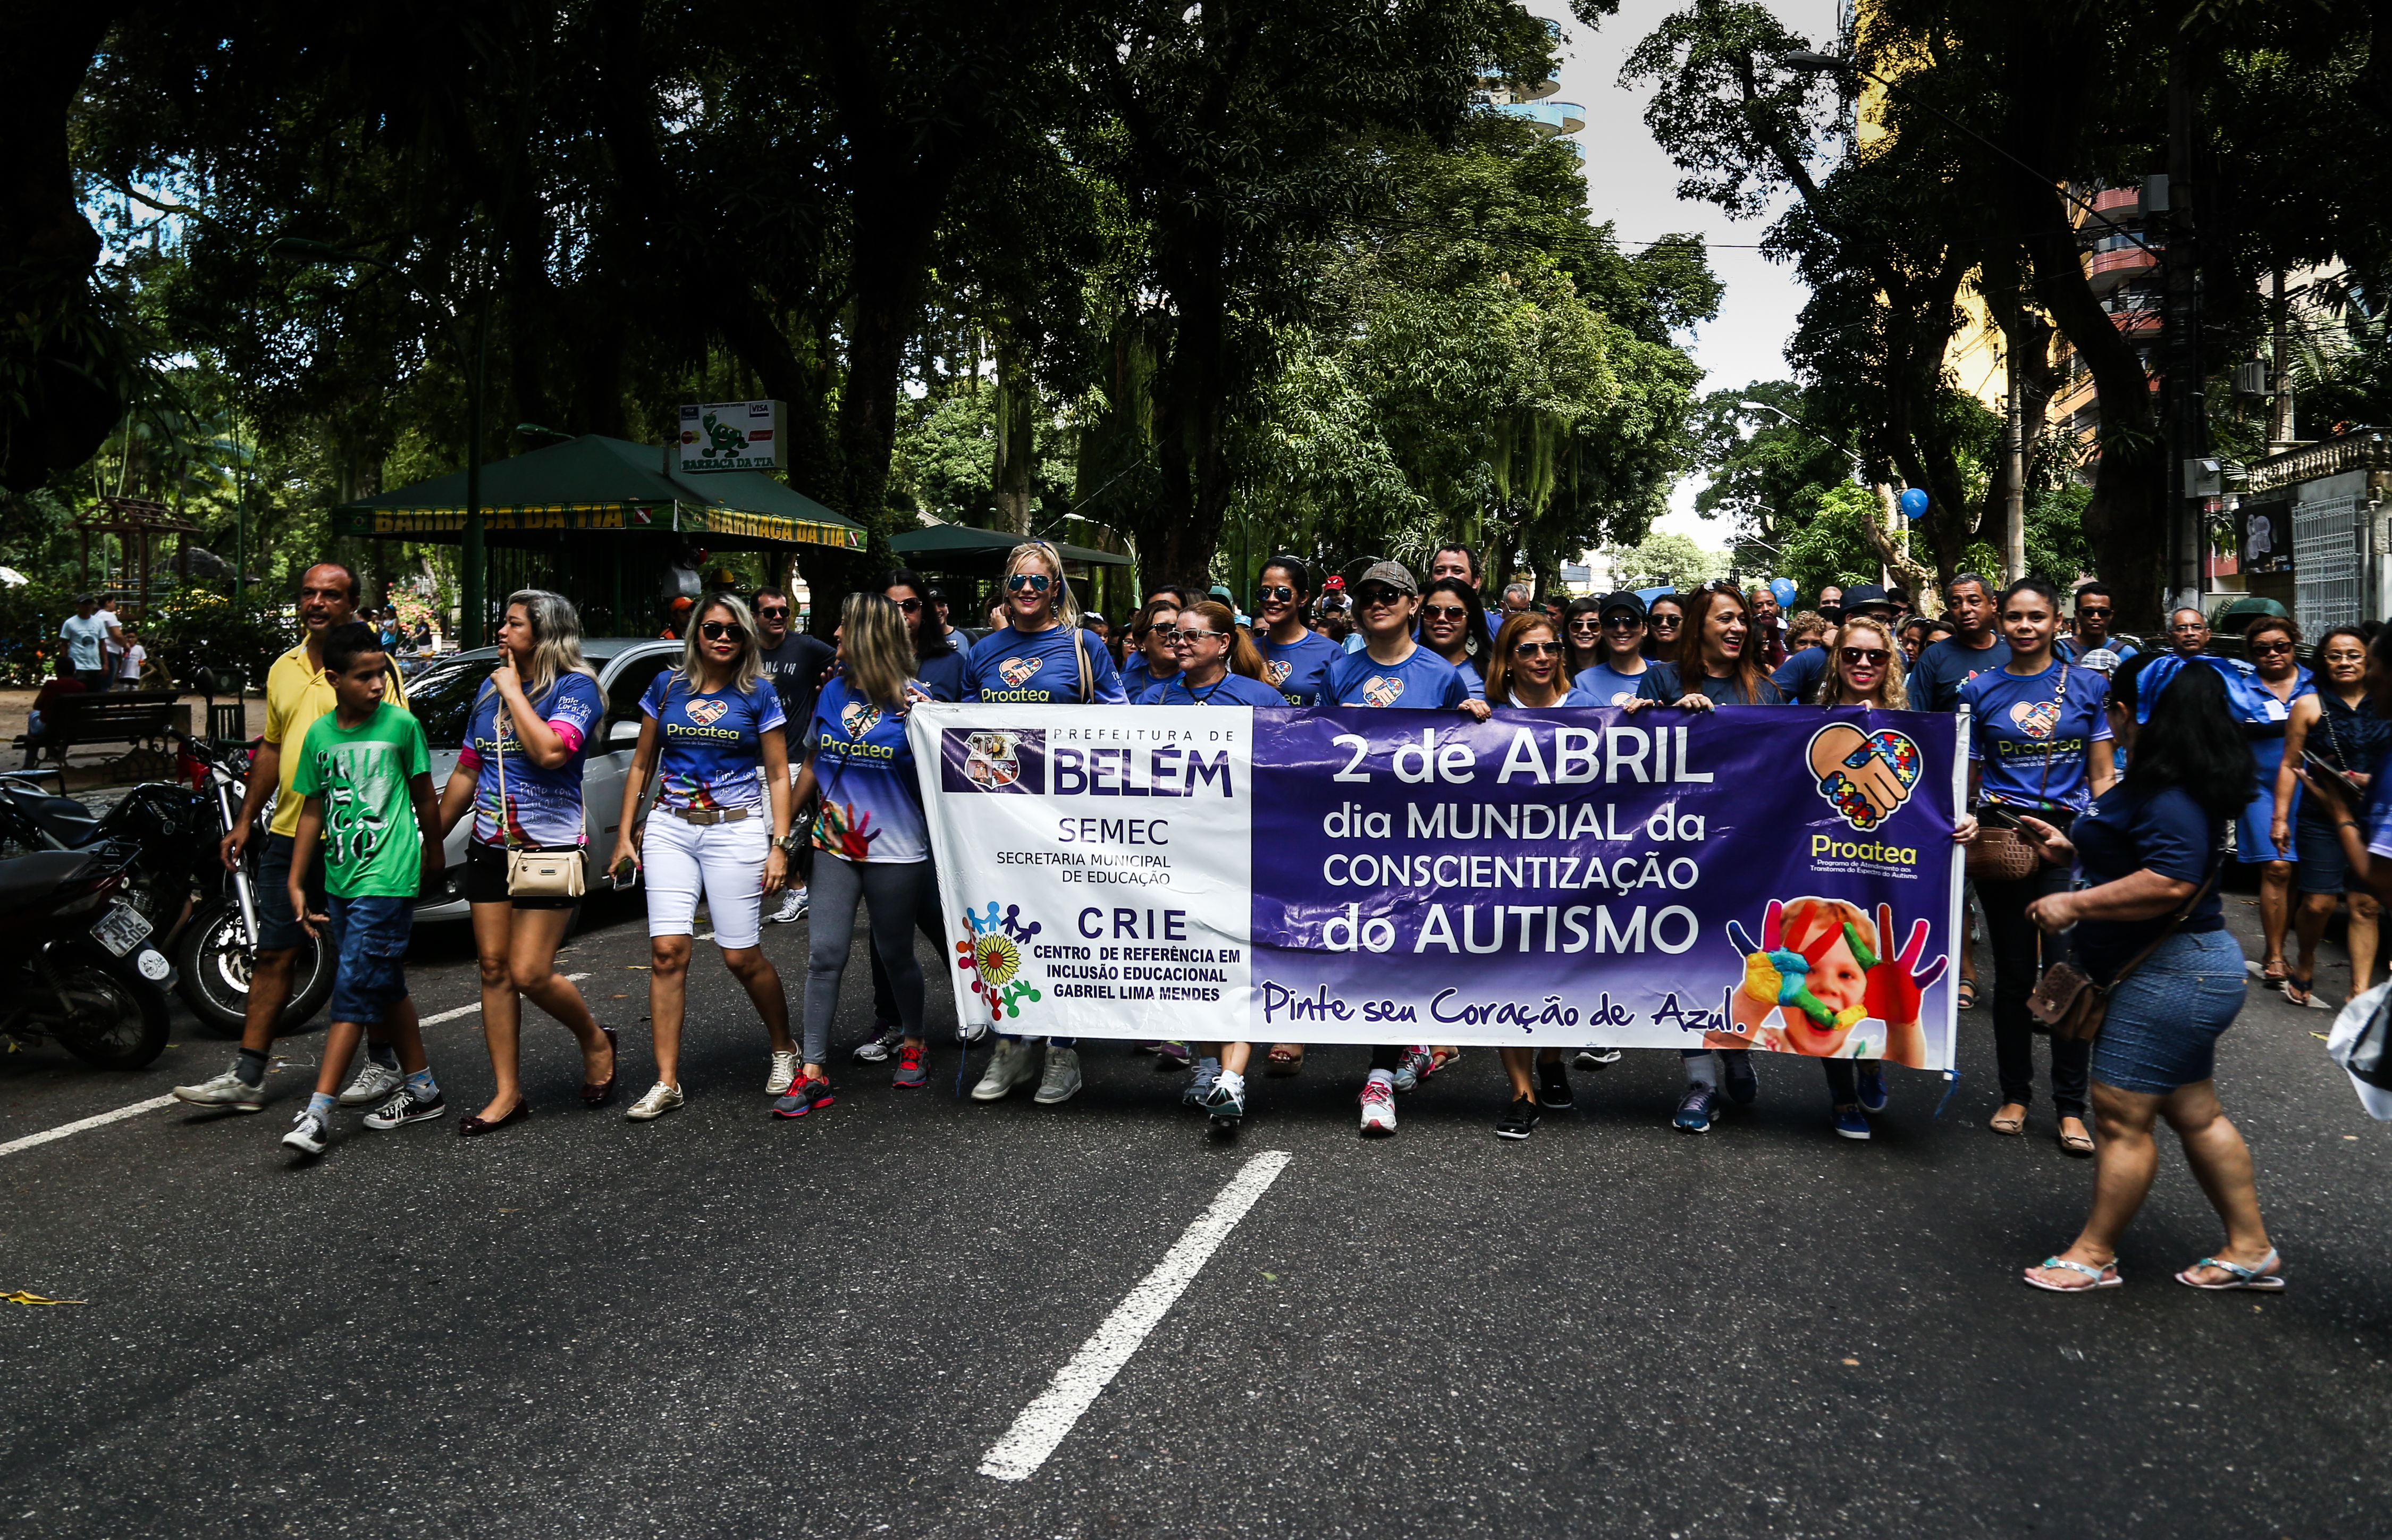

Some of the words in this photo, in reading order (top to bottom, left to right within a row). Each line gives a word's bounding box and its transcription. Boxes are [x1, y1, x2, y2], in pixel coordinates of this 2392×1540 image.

[682, 459, 735, 470] BARRACA
[737, 458, 753, 468] DA
[754, 457, 774, 467] TIA
[522, 504, 566, 529] DA
[571, 503, 624, 529] TIA
[707, 508, 793, 541] BARRACA
[796, 520, 818, 543] DA
[821, 523, 846, 547] TIA
[981, 687, 1050, 703] Proatea
[667, 723, 739, 739] Proatea
[1054, 729, 1192, 741] PREFEITURA
[1210, 731, 1233, 742] DE
[475, 737, 523, 751] Proate
[820, 734, 894, 759] Proatea
[1332, 734, 1371, 783] 2
[1392, 729, 1476, 784] de
[1496, 726, 1714, 784] ABRIL
[1054, 744, 1233, 797] BELÉM
[1058, 818, 1169, 845] SEMEC
[1323, 802, 1391, 839] dia
[1407, 803, 1633, 841] MUNDIAL
[1646, 803, 1706, 841] da
[997, 852, 1085, 866] SECRETARIA
[1091, 854, 1171, 868] MUNICIPAL
[1812, 835, 1916, 864] Proatea
[1062, 870, 1082, 882] DE
[1088, 870, 1170, 887] EDUCAÇÃO
[1323, 852, 1699, 896] CONSCIENTIZAÇÃO
[1857, 867, 1881, 876] Espectro
[1860, 861, 1899, 872] Atendimento
[1078, 907, 1186, 941] CRIE
[1323, 903, 1396, 954] do
[1413, 903, 1699, 955] AUTISMO
[115, 923, 148, 952] 1506
[1033, 945, 1090, 960] CENTRO
[1100, 946, 1118, 961] DE
[1123, 946, 1215, 963] REFERÊNCIA
[1219, 949, 1240, 963] EM
[1047, 963, 1118, 980] INCLUSÃO
[1123, 966, 1227, 982] EDUCACIONAL
[1054, 983, 1115, 999] GABRIEL
[1119, 986, 1155, 1000] LIMA
[1159, 987, 1219, 1002] MENDES
[1262, 981, 1354, 1024] Pinte
[1365, 1004, 1417, 1024] seu
[1430, 987, 1579, 1033] Coração
[1590, 992, 1634, 1027] de
[1650, 987, 1746, 1032] Azul.
